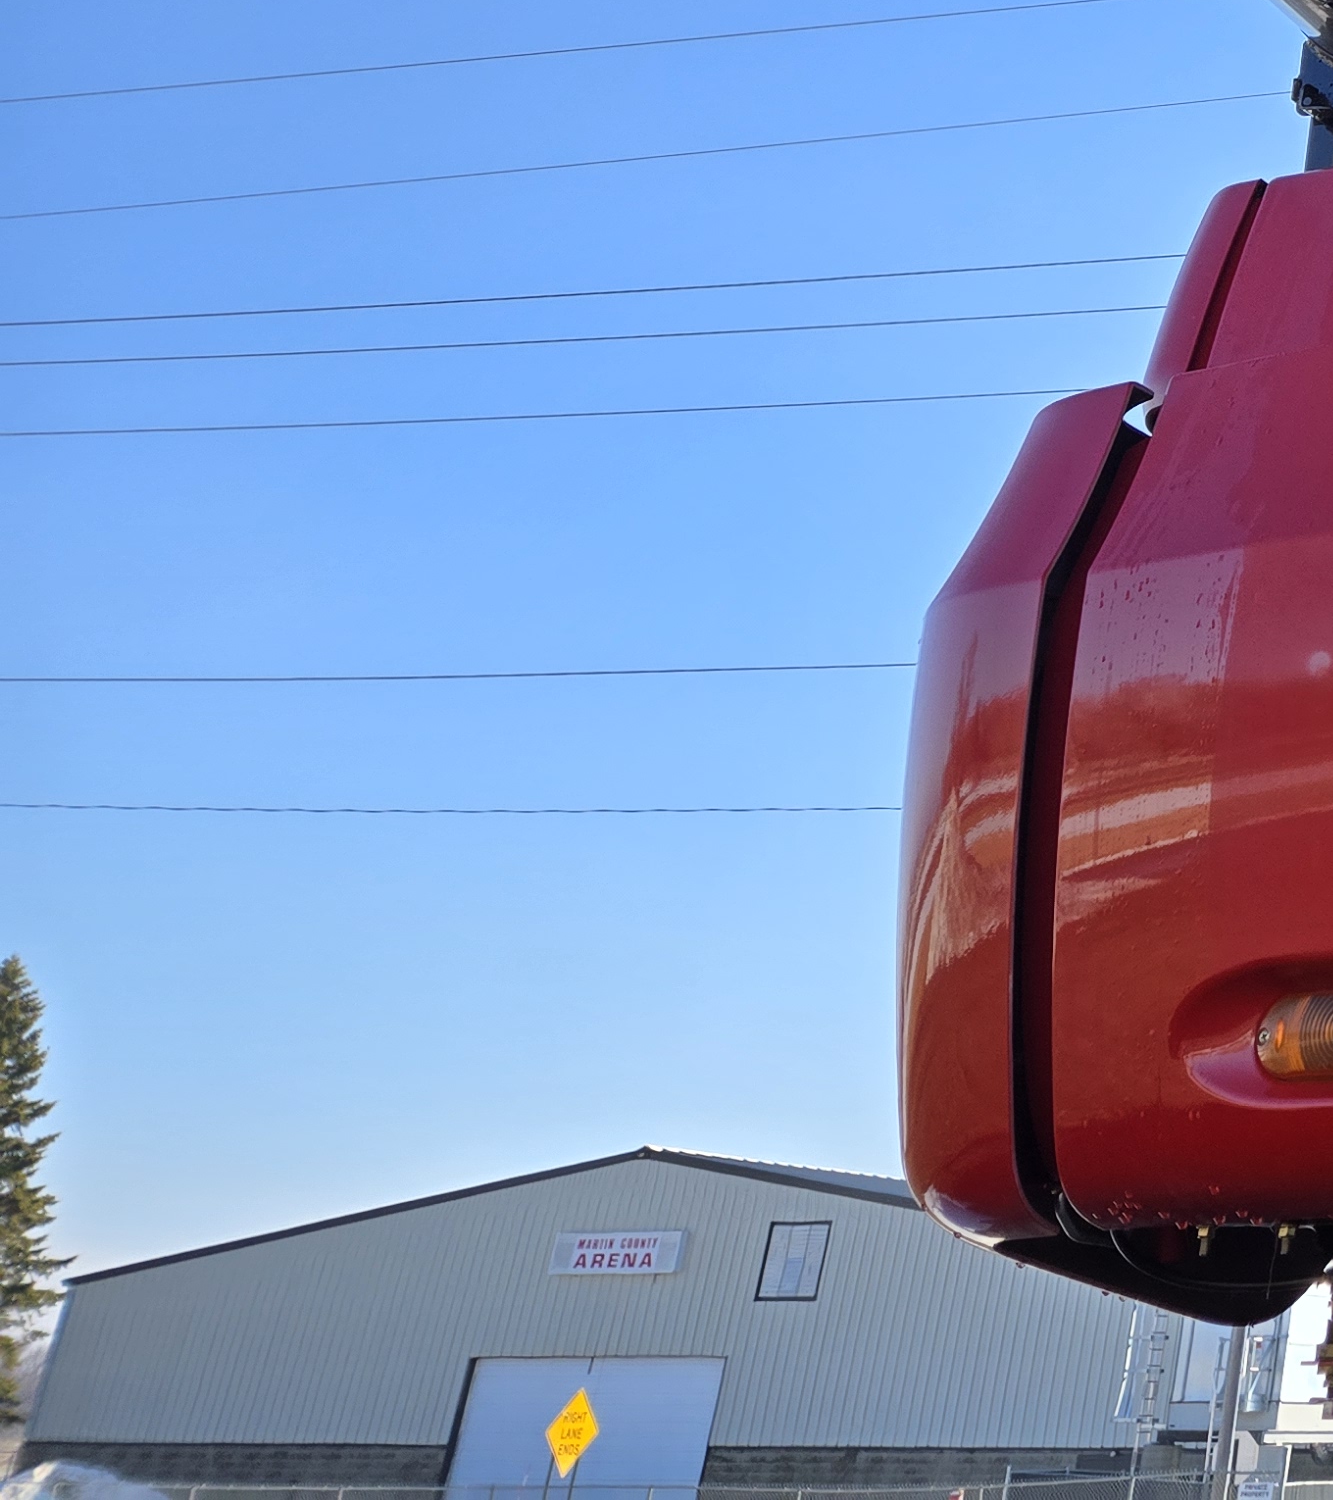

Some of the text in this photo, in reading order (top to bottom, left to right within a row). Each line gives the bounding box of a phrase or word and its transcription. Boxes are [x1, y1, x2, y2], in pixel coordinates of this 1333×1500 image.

[577, 1237, 659, 1249] MARTIN COUNTY
[572, 1252, 652, 1269] ARENA
[563, 1411, 588, 1424] RIGHT
[560, 1427, 583, 1440] LANE
[557, 1443, 580, 1456] ENDS
